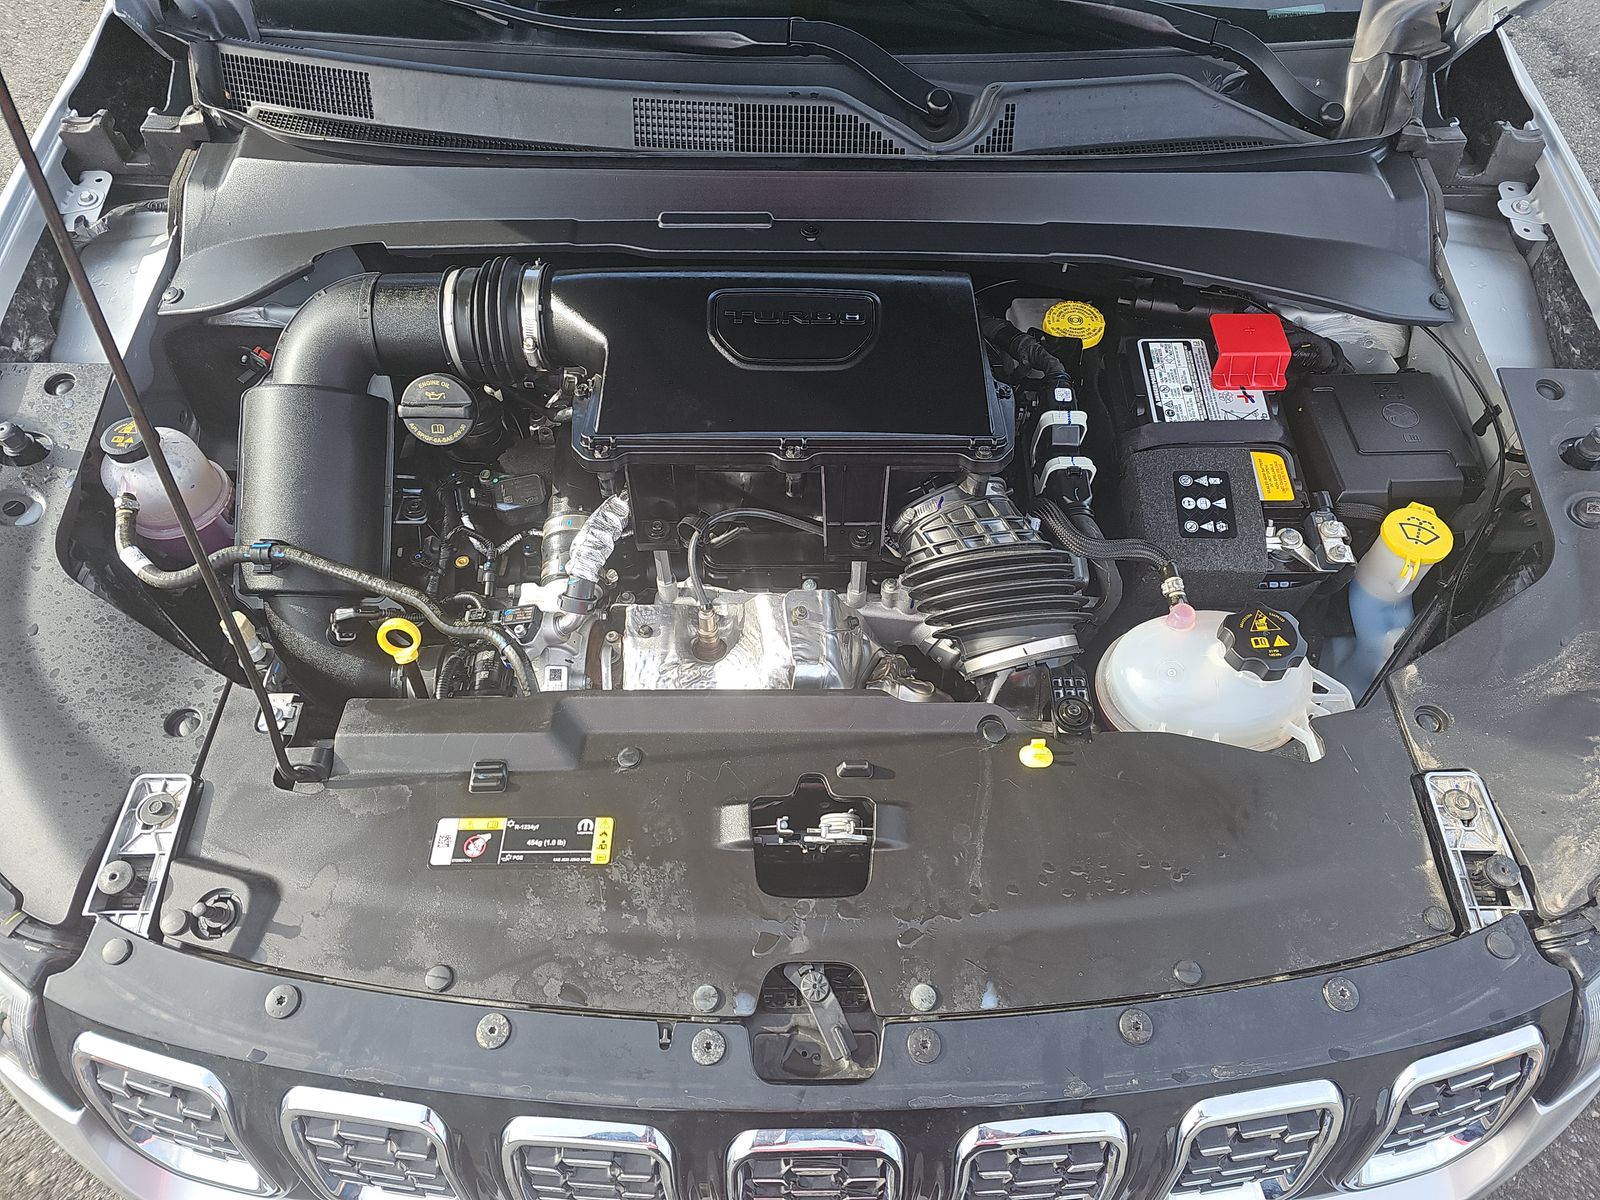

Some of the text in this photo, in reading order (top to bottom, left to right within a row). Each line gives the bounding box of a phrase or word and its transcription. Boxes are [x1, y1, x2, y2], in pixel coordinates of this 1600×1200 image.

[724, 311, 866, 324] TURBO
[418, 380, 450, 389] ENGINE OIL
[514, 823, 540, 831] R-1234yf
[526, 839, 566, 848] 454g (1.0 lb)
